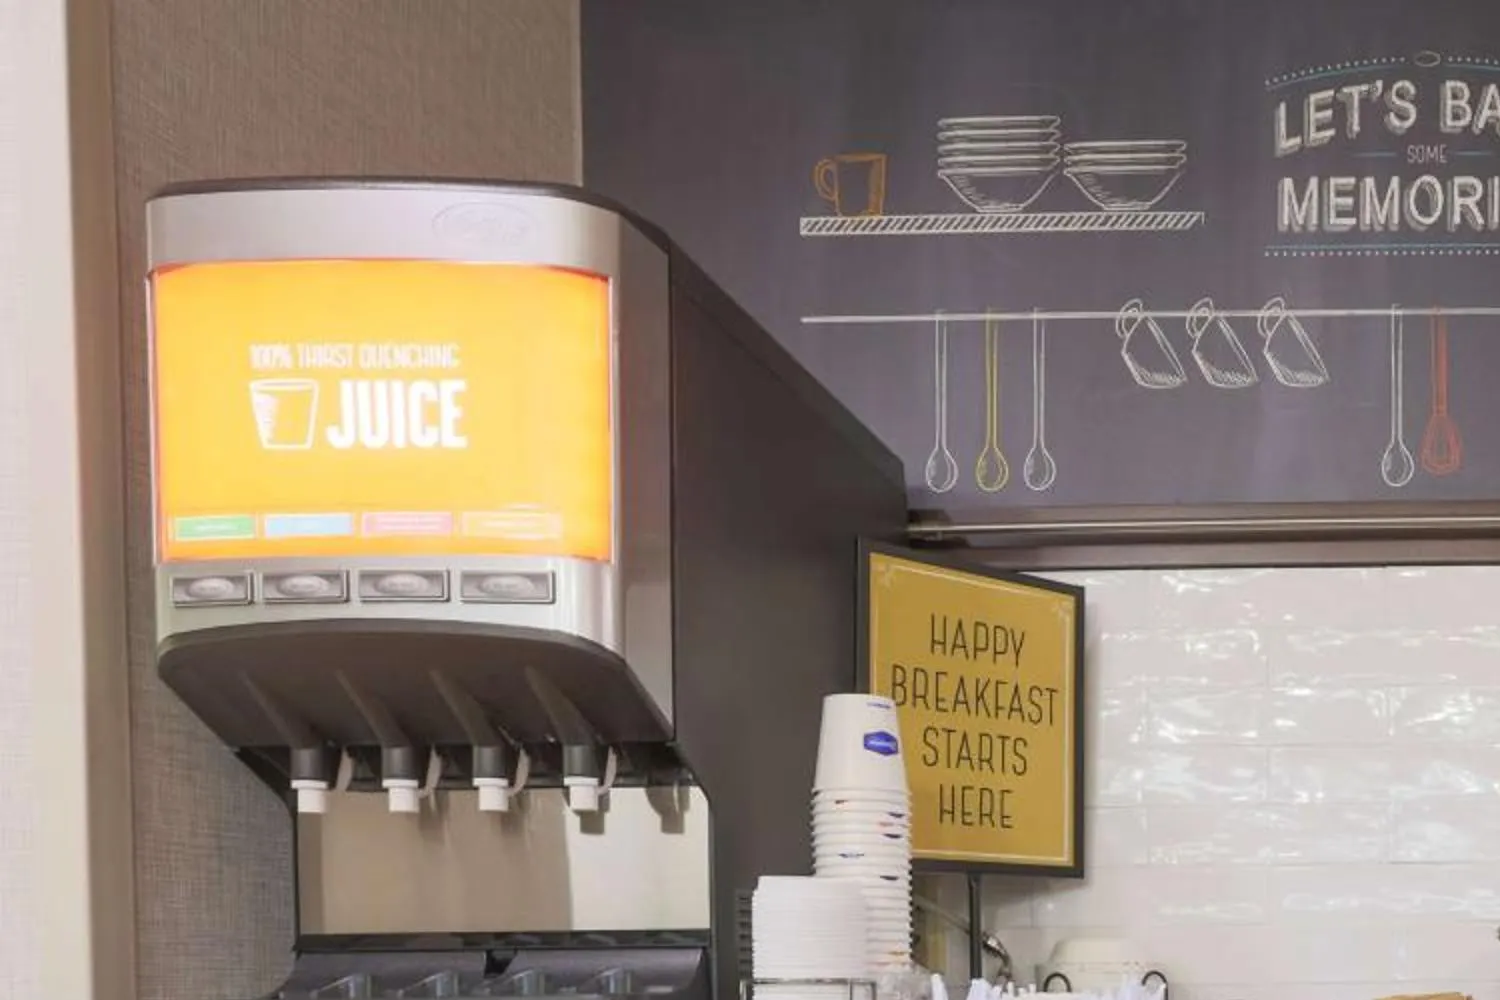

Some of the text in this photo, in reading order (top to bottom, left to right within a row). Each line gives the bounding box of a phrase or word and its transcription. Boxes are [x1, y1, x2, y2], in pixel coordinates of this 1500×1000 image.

[1274, 79, 1418, 157] LET'S
[1406, 144, 1448, 164] SOME
[297, 343, 353, 369] THIRST
[359, 343, 460, 369] QUENCHING
[326, 379, 468, 449] JUICE
[930, 613, 1026, 667] HAPPY
[891, 664, 1059, 726] BREAKFAST
[922, 726, 1028, 776] STARTS
[938, 784, 1014, 829] HERE
